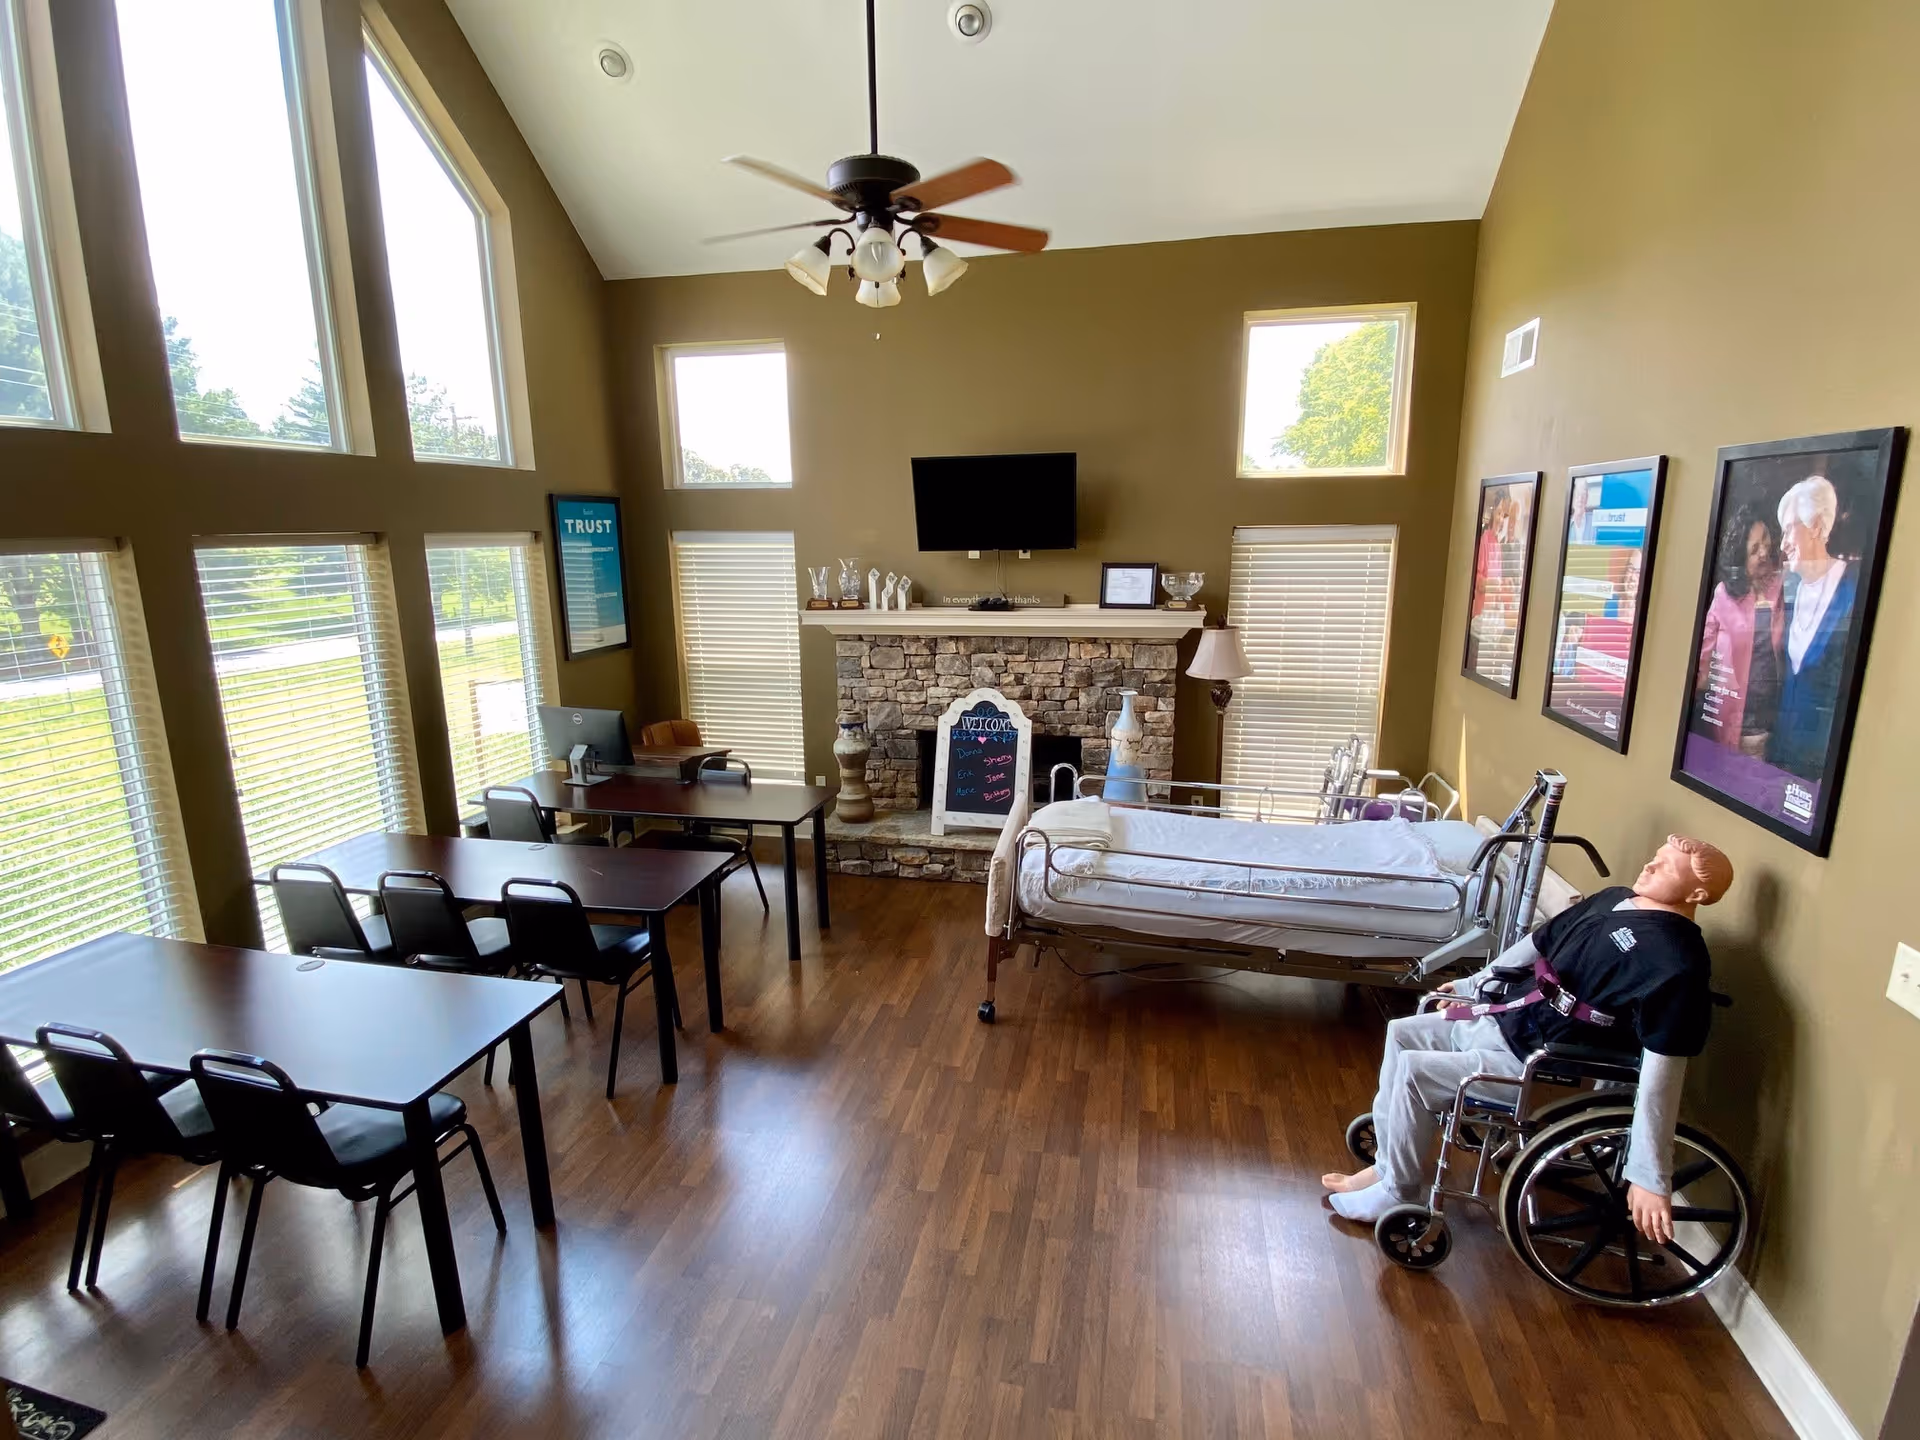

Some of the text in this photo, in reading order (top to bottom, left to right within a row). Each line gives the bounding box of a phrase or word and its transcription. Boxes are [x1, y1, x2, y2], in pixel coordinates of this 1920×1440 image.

[564, 518, 612, 534] TRUST
[952, 593, 985, 606] everyth
[1014, 594, 1041, 604] thanks
[961, 716, 1011, 732] WELCOME
[956, 747, 983, 760] Donna
[957, 769, 975, 780] Erik
